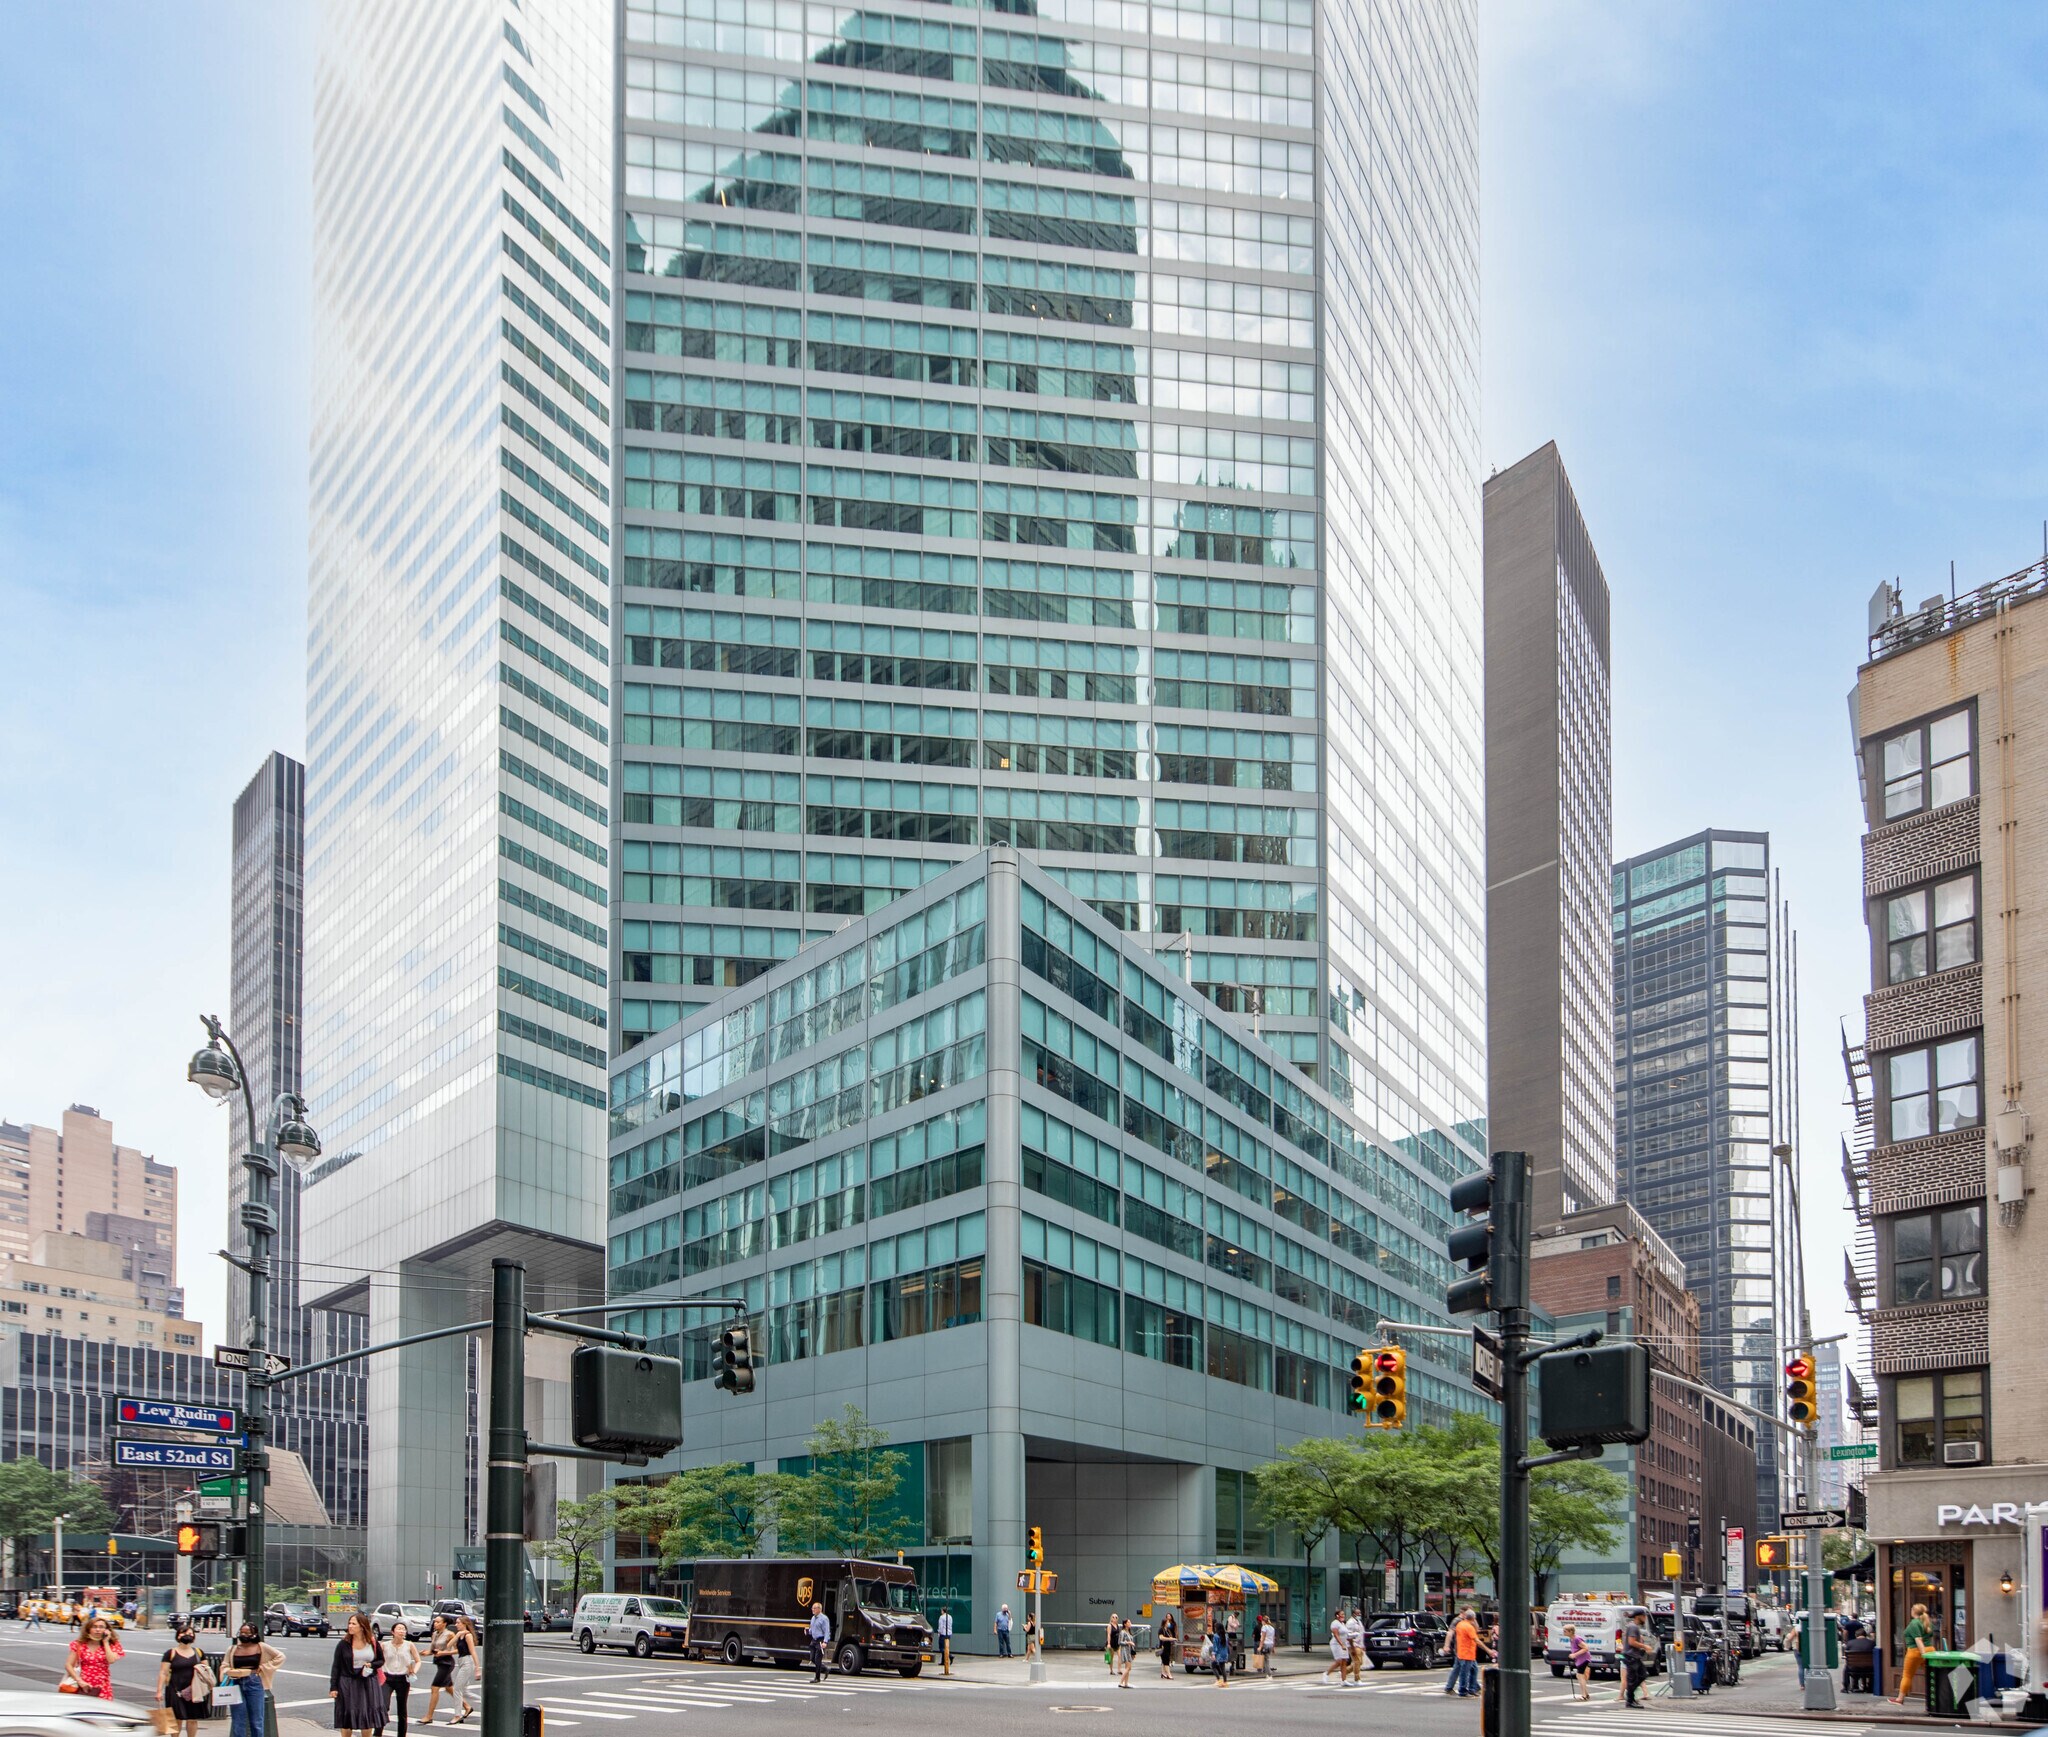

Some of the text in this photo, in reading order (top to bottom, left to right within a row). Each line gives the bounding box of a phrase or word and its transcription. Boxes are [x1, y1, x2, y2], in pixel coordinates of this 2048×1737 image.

[225, 1353, 280, 1370] ONE AY
[1480, 1349, 1493, 1378] ONE
[138, 1403, 217, 1422] Lew Rudin
[169, 1417, 188, 1427] Way
[121, 1446, 229, 1465] East 52nd St
[1832, 1447, 1867, 1458] Lexington
[1790, 1515, 1836, 1525] ONE WAY
[459, 1571, 486, 1579] Subway
[798, 1585, 812, 1602] ups
[1088, 1597, 1115, 1606] Subway
[1656, 1603, 1675, 1612] FedE
[1958, 1610, 1964, 1620] A
